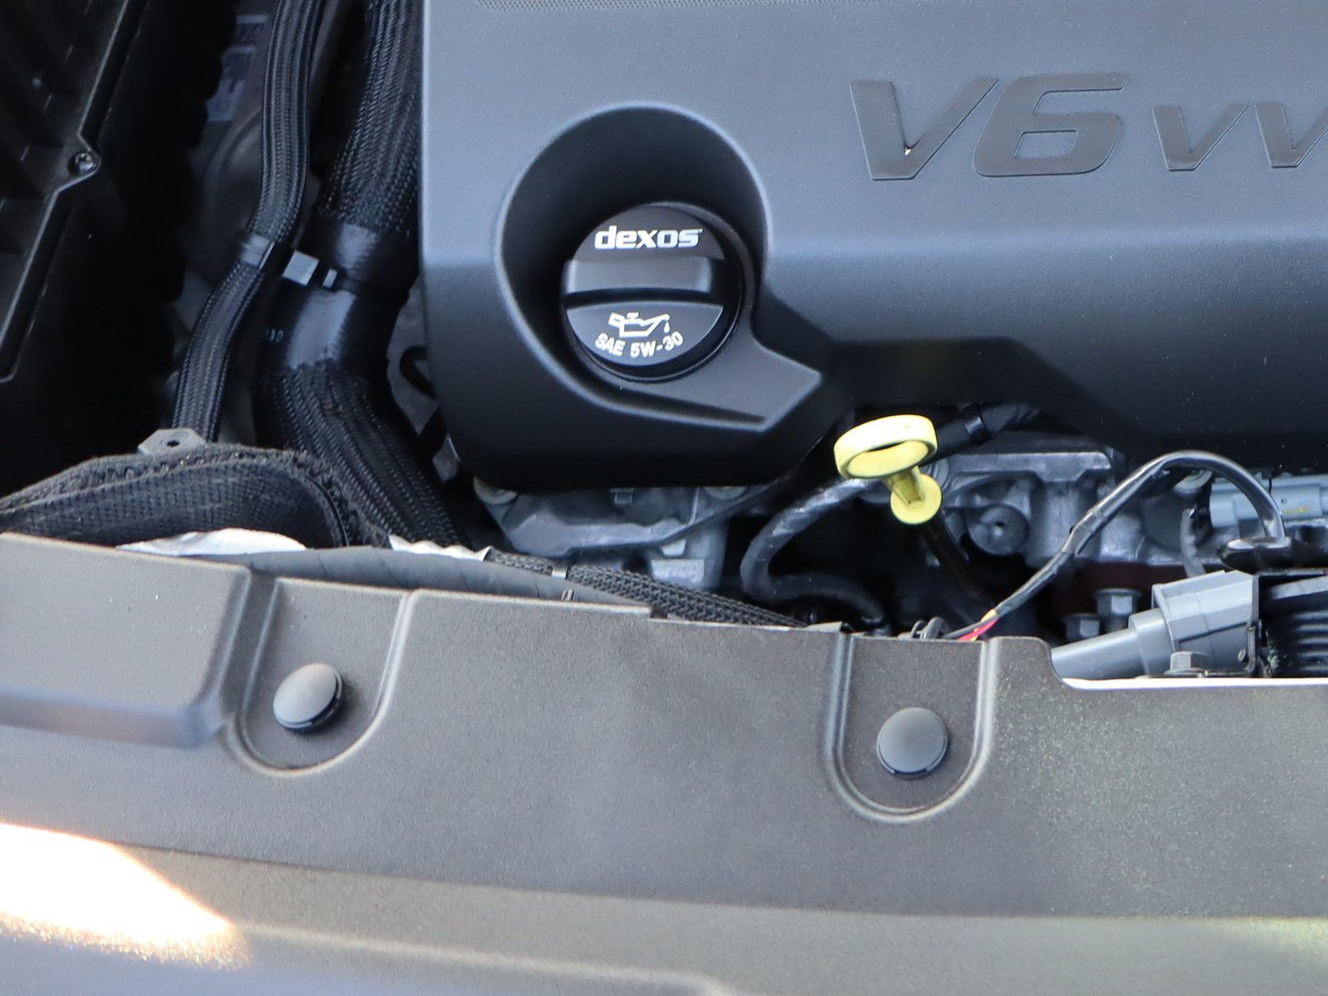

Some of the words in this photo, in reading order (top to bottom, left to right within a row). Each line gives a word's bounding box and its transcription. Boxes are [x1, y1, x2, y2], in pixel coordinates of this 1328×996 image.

[849, 72, 1129, 181] V6
[594, 225, 703, 249] dexos
[595, 332, 625, 357] SAE
[629, 331, 684, 358] 5W-30
